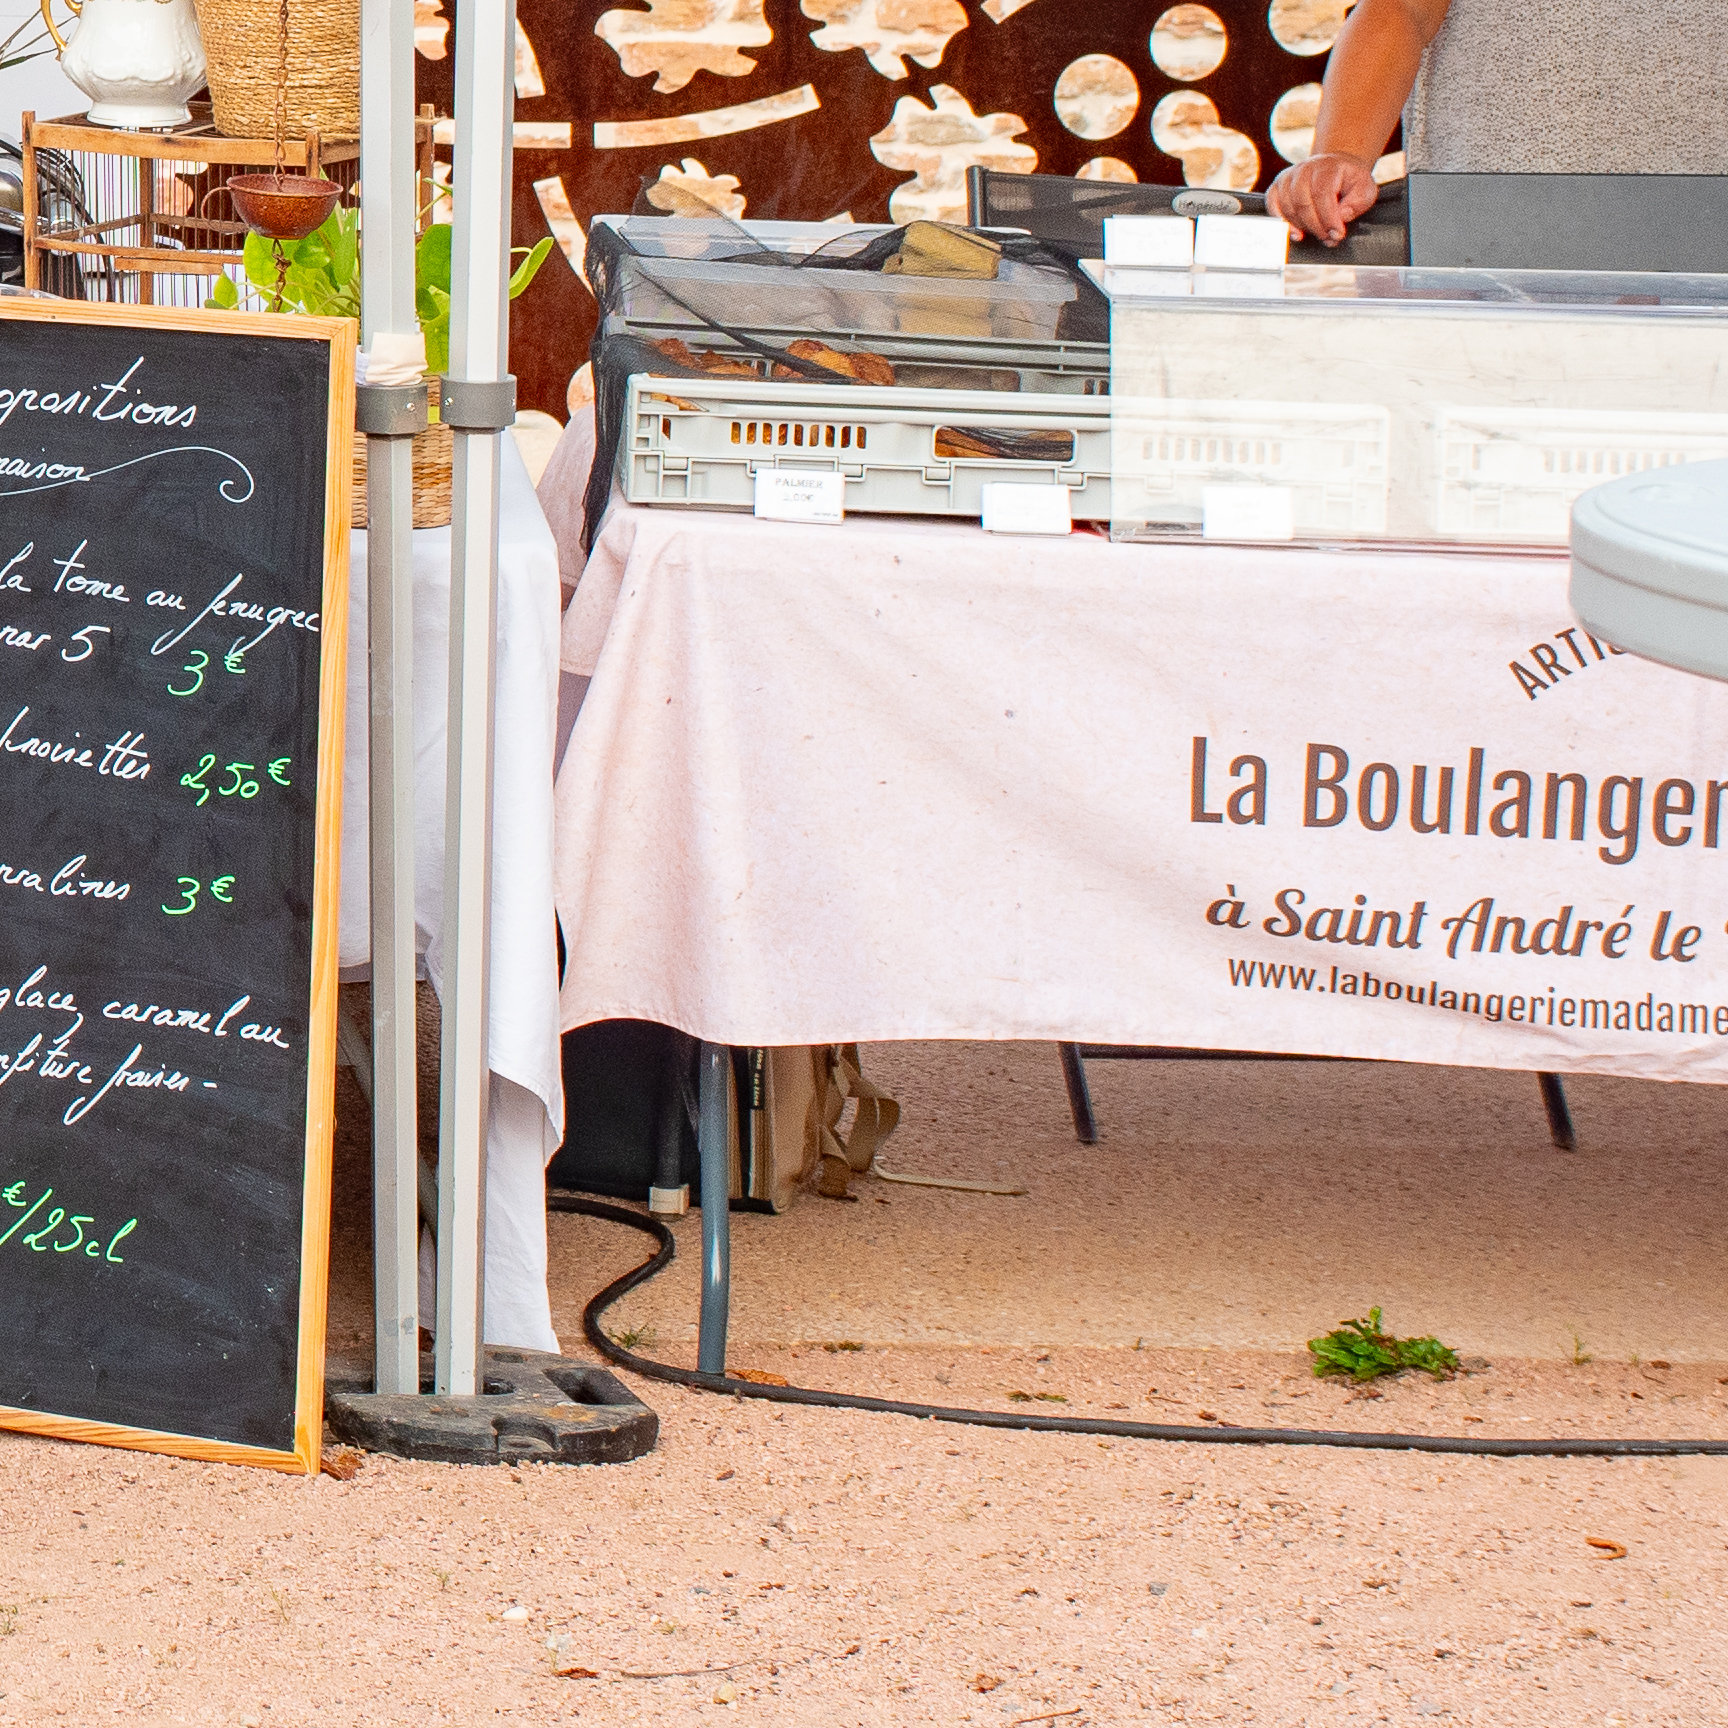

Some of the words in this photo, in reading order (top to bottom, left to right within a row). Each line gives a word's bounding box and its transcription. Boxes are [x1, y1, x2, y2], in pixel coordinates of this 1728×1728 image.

[54, 539, 131, 604] tome
[146, 586, 186, 610] au
[61, 624, 110, 663] 5
[151, 574, 320, 657] fenugrec
[180, 754, 291, 807] 2,50€
[1190, 736, 1268, 826] La
[1301, 742, 1728, 866] Boulanger
[161, 876, 236, 915] 3€
[1205, 884, 1252, 929] à
[1261, 887, 1428, 951] Saint
[1440, 896, 1637, 960] André
[1649, 909, 1702, 964] le
[103, 995, 247, 1039] caramel
[238, 1018, 290, 1050] au
[1227, 959, 1728, 1036] www.laboulangeriemadame
